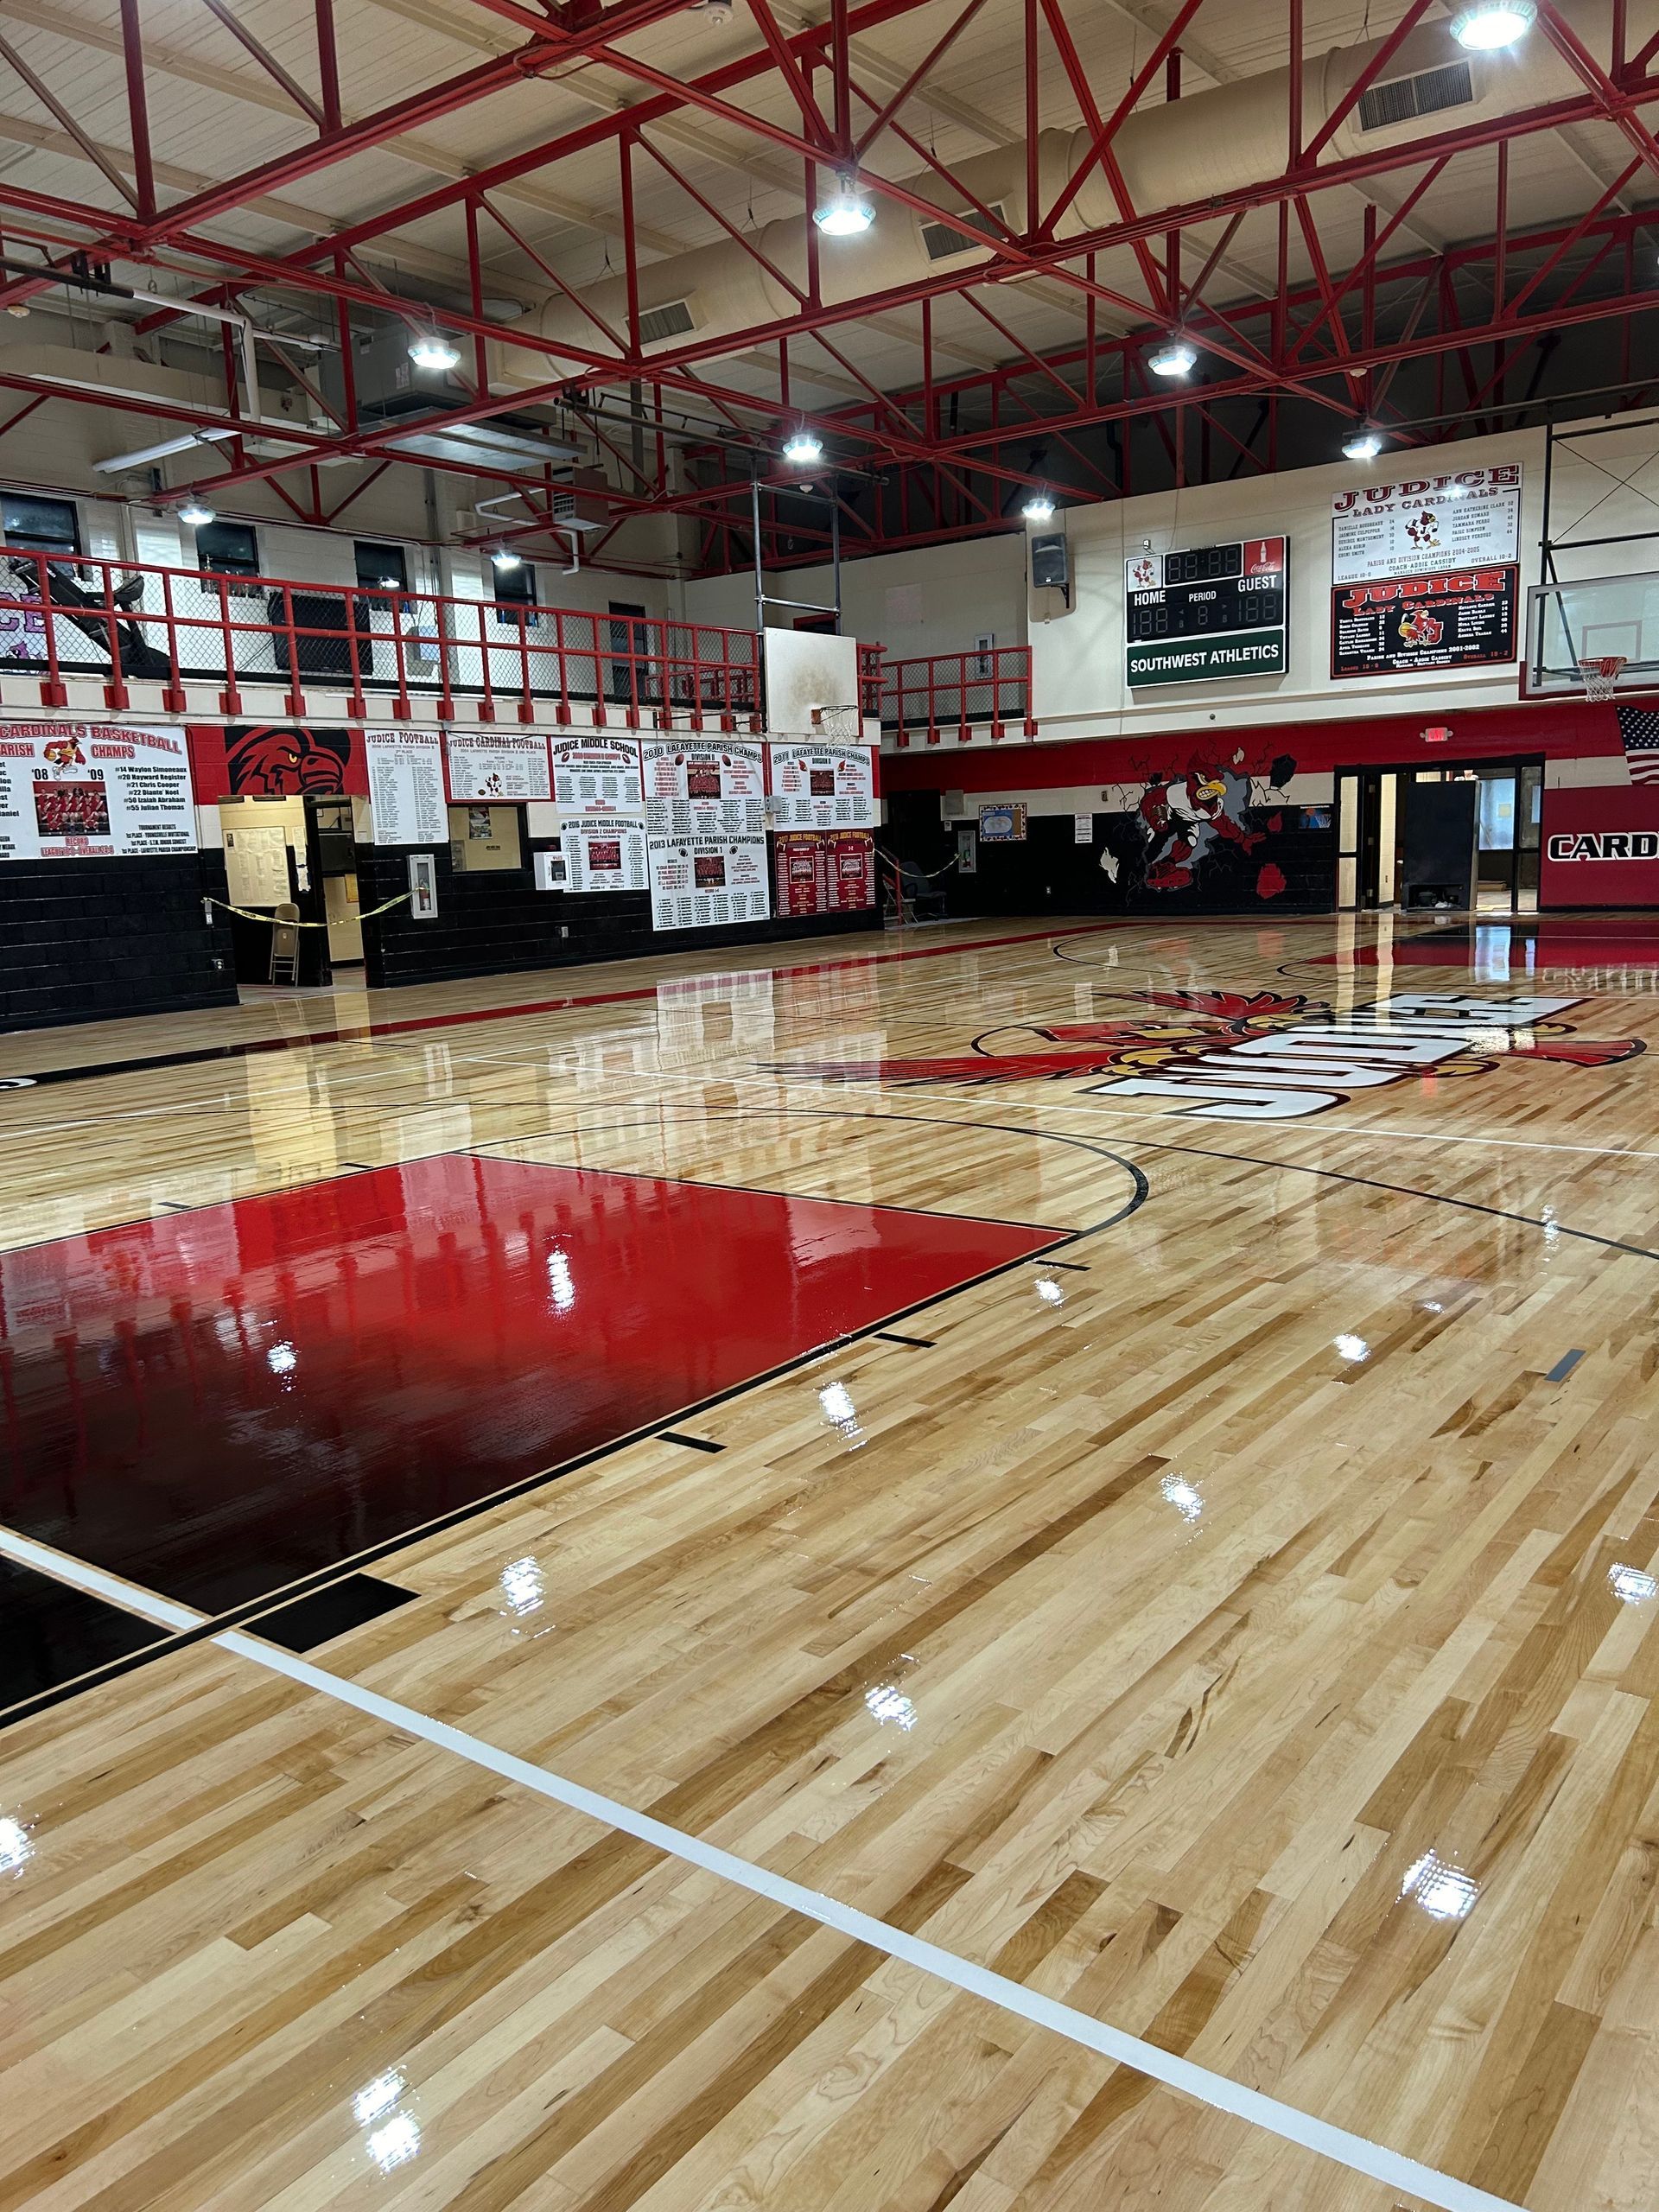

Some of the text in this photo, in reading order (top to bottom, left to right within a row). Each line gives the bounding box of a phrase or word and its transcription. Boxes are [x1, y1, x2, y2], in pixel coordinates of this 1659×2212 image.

[1334, 464, 1520, 512] JUDICE
[1352, 503, 1395, 518] LADY
[1421, 552, 1451, 562] CHAMPIONS
[1471, 555, 1497, 563] OVERALL
[1237, 575, 1277, 593] GUEST
[1342, 570, 1506, 608] JUDICE
[1134, 590, 1166, 607] HOME
[1188, 590, 1217, 603] PERIOD
[1352, 604, 1395, 617] LADY
[1402, 593, 1495, 610] CARDINALS
[1130, 644, 1280, 672] SOUTHWEST ATHLETICS
[0, 724, 183, 756] CARDINALS BASKETBALL
[366, 731, 439, 745] JUDICE FOOTBALL
[448, 736, 546, 750] JUDICE CARDINAL FOOTBALL
[91, 744, 137, 759] CHAMPS
[553, 738, 639, 759] JUDICE MIDDLE SCHOOL
[643, 741, 764, 765] 2010 LAFAYETTE PARISH CHAMPS
[791, 746, 823, 760] LAFAYETTE
[823, 747, 846, 759] PARISH
[846, 750, 871, 767] CHAMPS
[614, 820, 639, 829] FOOTBALL
[649, 836, 765, 850] 2013 LAFAYETTE PARISH CHAMPIONS
[1547, 831, 1658, 862] CARD
[1075, 993, 1593, 1121] JUDICE
